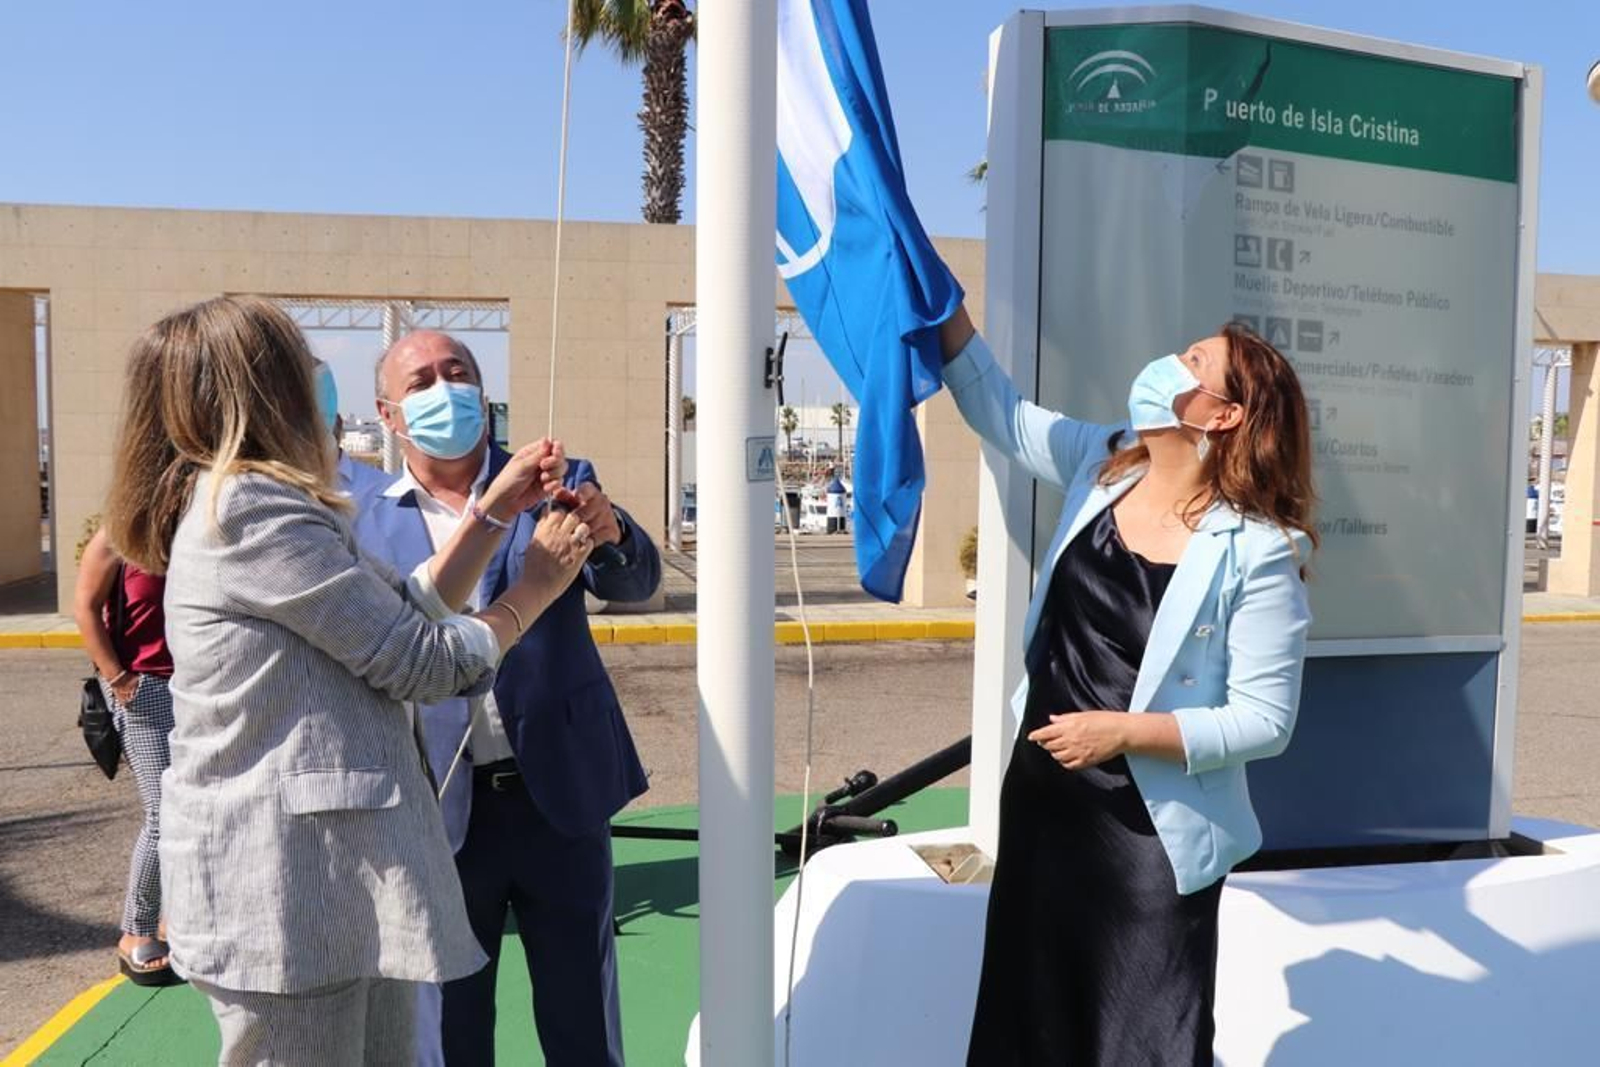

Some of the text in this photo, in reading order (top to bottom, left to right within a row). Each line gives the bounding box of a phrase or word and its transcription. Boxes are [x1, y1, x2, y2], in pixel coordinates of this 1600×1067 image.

[1282, 104, 1304, 128] de
[1312, 108, 1343, 135] Isla
[1350, 113, 1419, 146] Cristina
[1235, 192, 1280, 216] Rampa
[1284, 200, 1300, 217] de
[1304, 200, 1331, 221] Vela
[1234, 273, 1279, 295] Muelle
